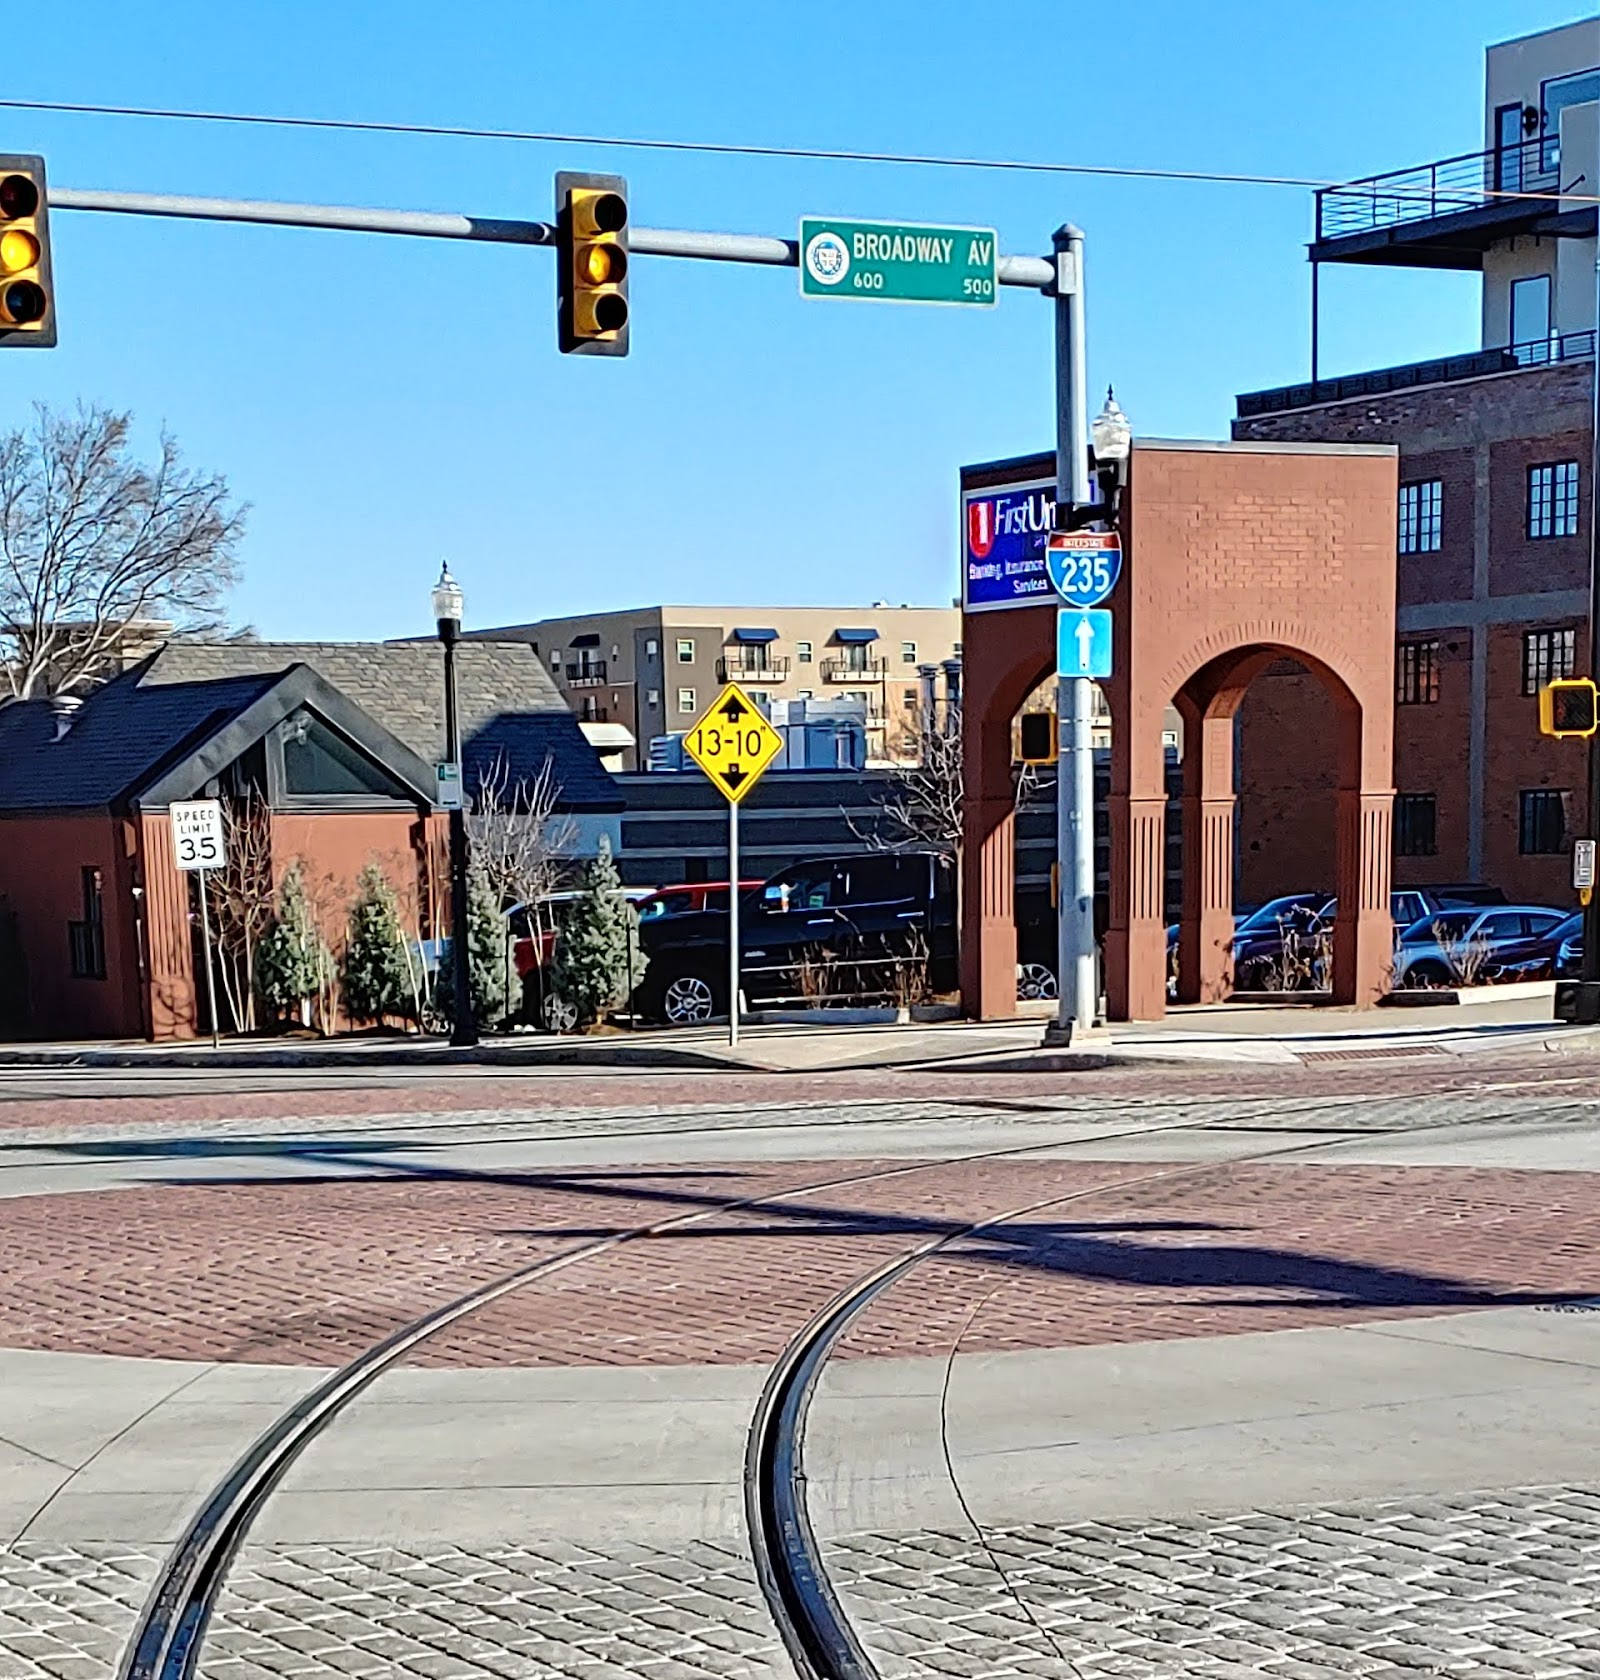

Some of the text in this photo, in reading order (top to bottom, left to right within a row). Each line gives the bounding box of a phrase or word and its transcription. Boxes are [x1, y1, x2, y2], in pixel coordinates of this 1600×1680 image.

[853, 232, 992, 266] BROADWAY AV
[853, 272, 884, 289] 600
[963, 278, 992, 296] 500
[1061, 556, 1110, 594] 235
[176, 810, 215, 822] SPEED
[180, 823, 212, 834] LIMIT
